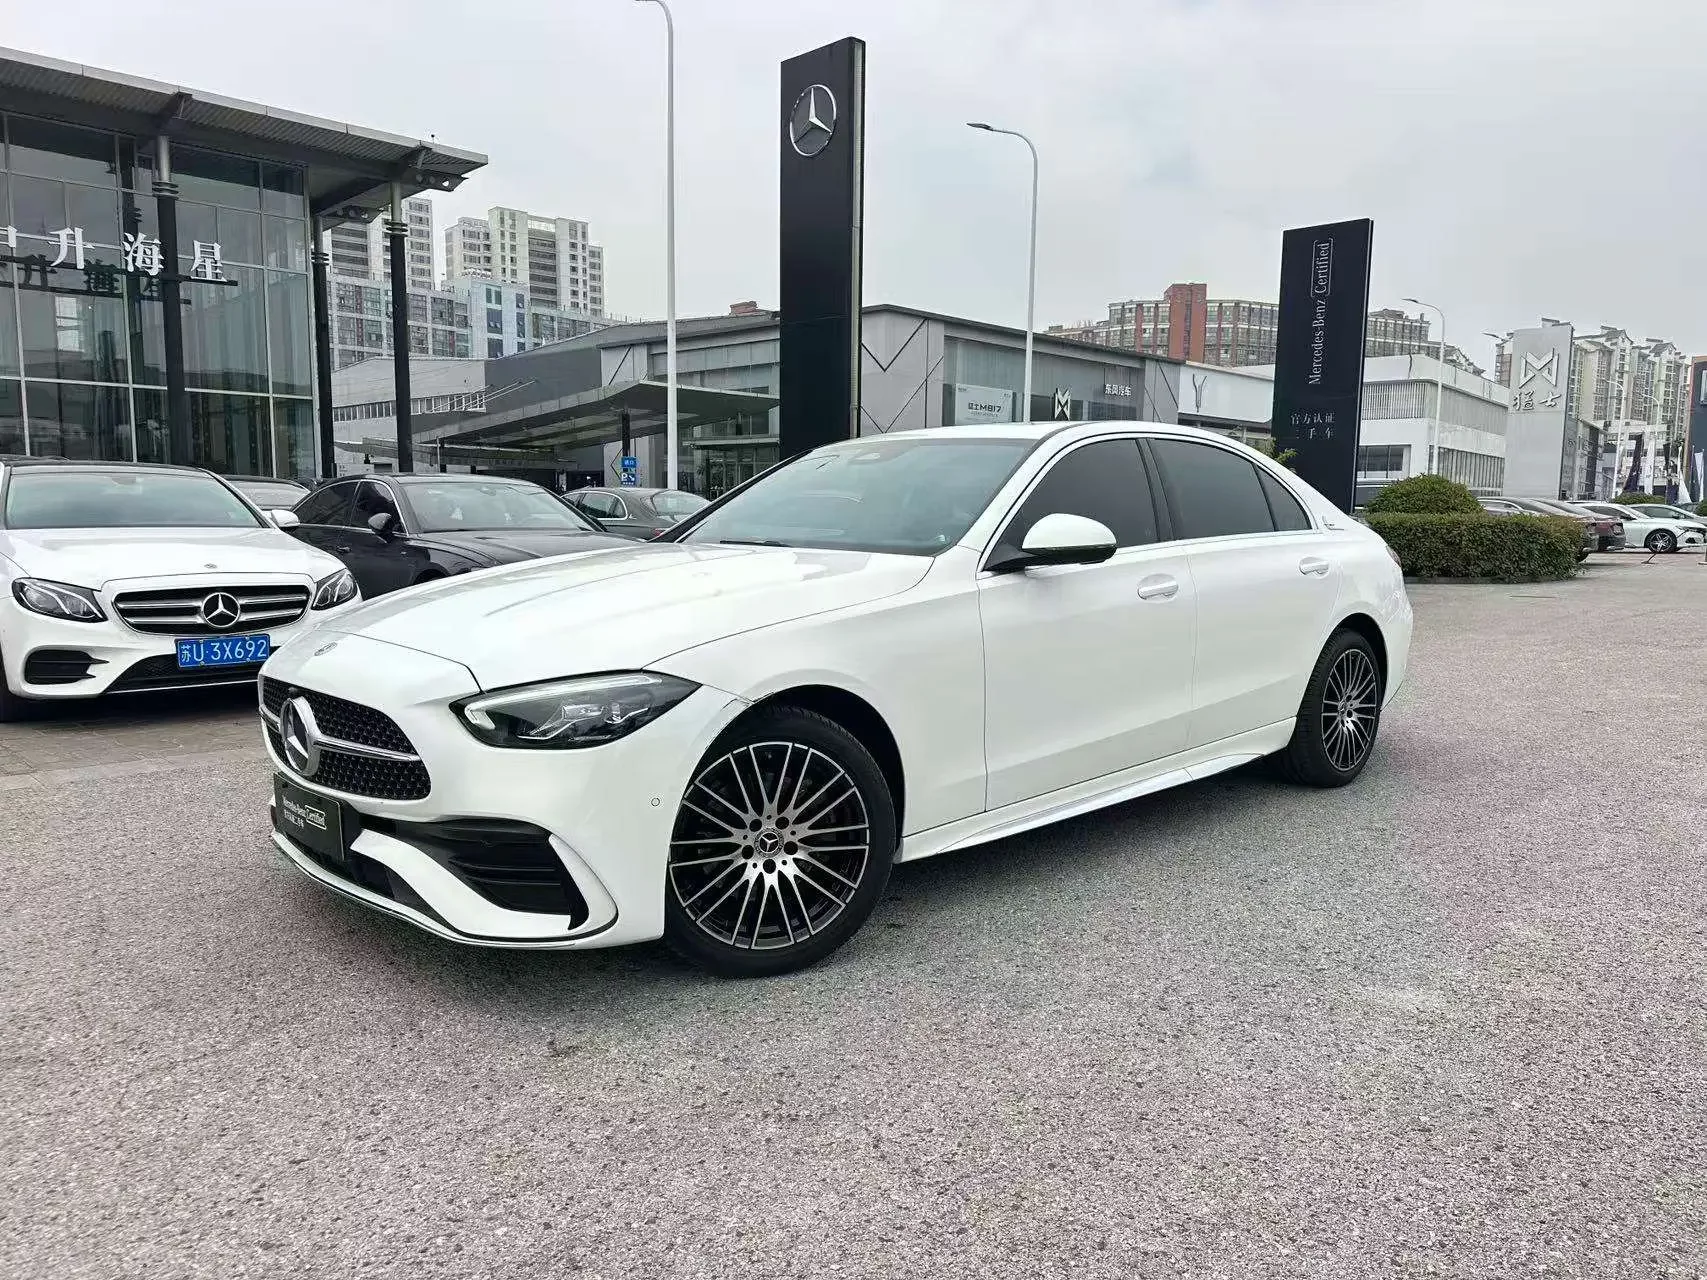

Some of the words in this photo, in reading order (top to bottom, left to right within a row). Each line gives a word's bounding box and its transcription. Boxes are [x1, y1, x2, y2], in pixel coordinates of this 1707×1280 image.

[1314, 242, 1330, 293] Certified
[1309, 300, 1326, 384] Mercedes-Benz
[1105, 384, 1132, 396] 东风汽车
[1512, 391, 1561, 411] 猛士
